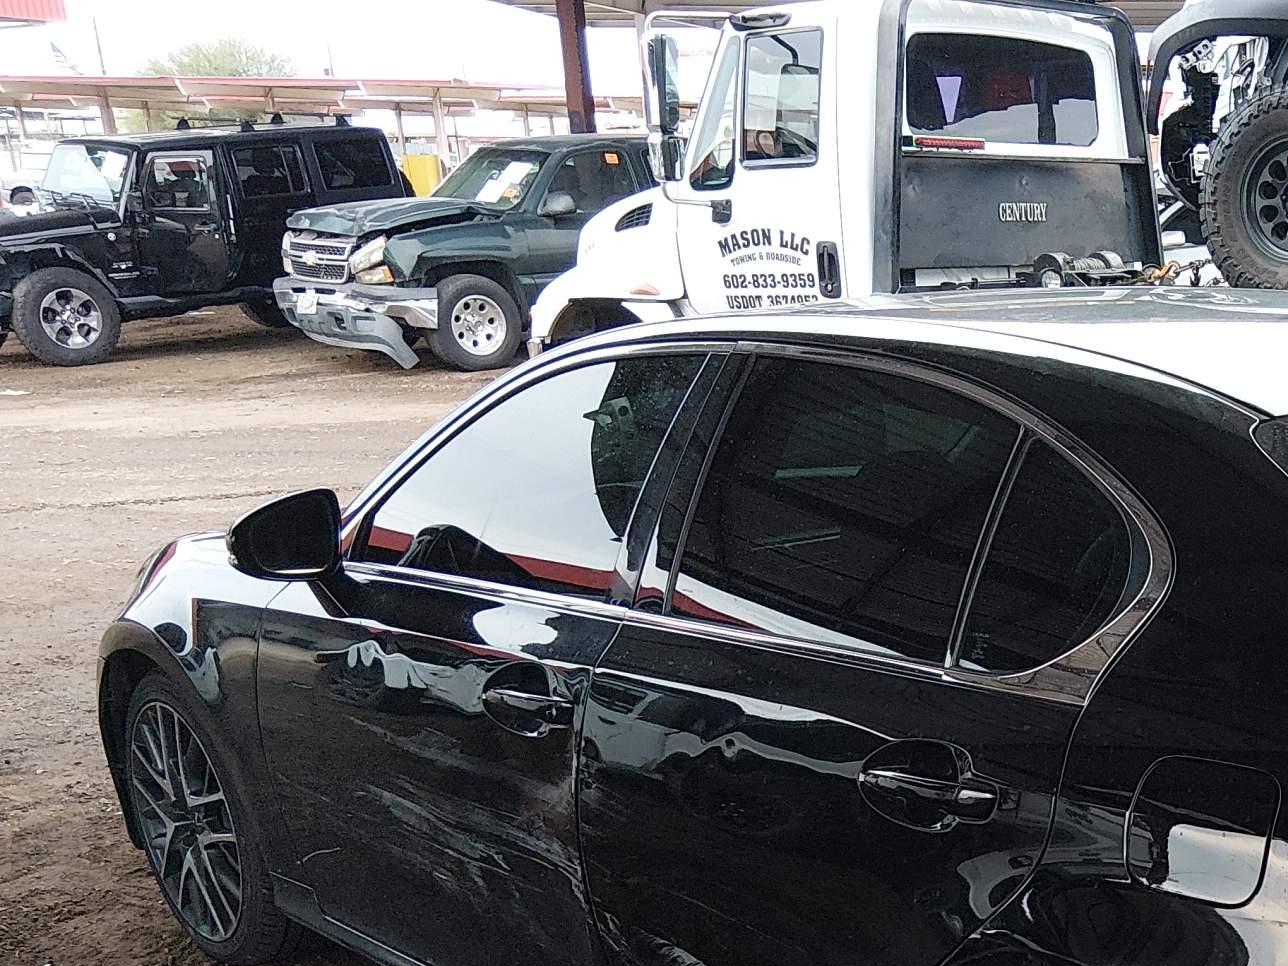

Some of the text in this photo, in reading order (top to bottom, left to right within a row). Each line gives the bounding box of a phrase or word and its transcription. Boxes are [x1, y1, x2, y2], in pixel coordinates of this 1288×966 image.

[999, 202, 1047, 221] CENTURY
[718, 228, 811, 258] MASON LLC
[730, 251, 801, 267] TOWING & ROADSIDE
[723, 273, 816, 289] 602-833-9359
[726, 294, 763, 309] USDOT
